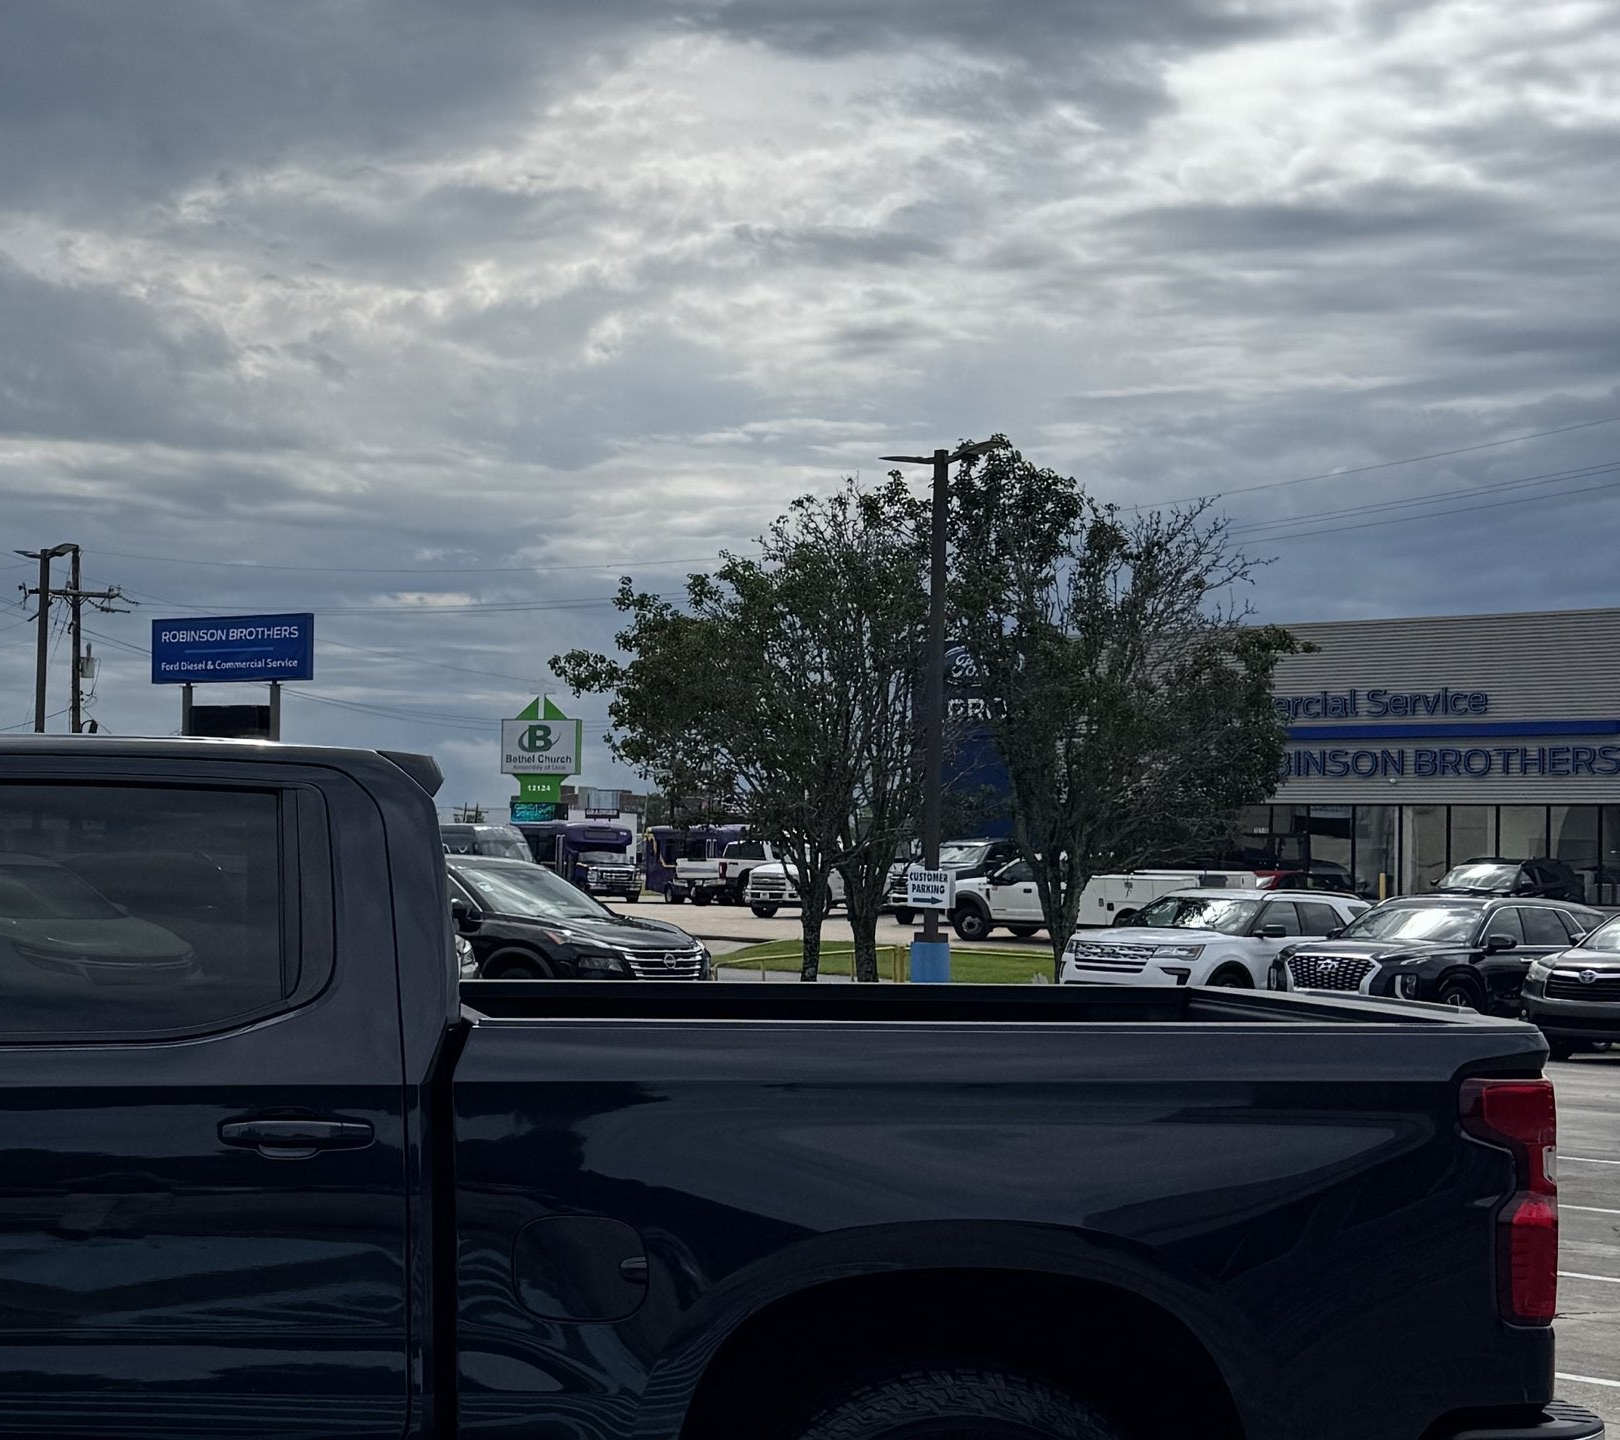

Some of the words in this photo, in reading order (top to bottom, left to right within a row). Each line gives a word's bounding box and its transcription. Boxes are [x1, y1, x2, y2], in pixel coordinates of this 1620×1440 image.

[161, 629, 226, 643] ROBINSON
[228, 626, 299, 640] BROTHERS
[161, 661, 179, 671] Ford
[181, 660, 206, 671] Diesel
[215, 659, 265, 670] Commercial
[267, 658, 298, 668] Service
[1273, 689, 1358, 718] ercial
[1367, 688, 1488, 717] Service
[506, 755, 535, 763] Bethel
[538, 755, 572, 764] Church
[1279, 749, 1405, 778] BINSON
[1414, 746, 1620, 777] BROTHERS
[909, 872, 948, 883] CUSTOMER
[912, 883, 945, 894] PARKING
